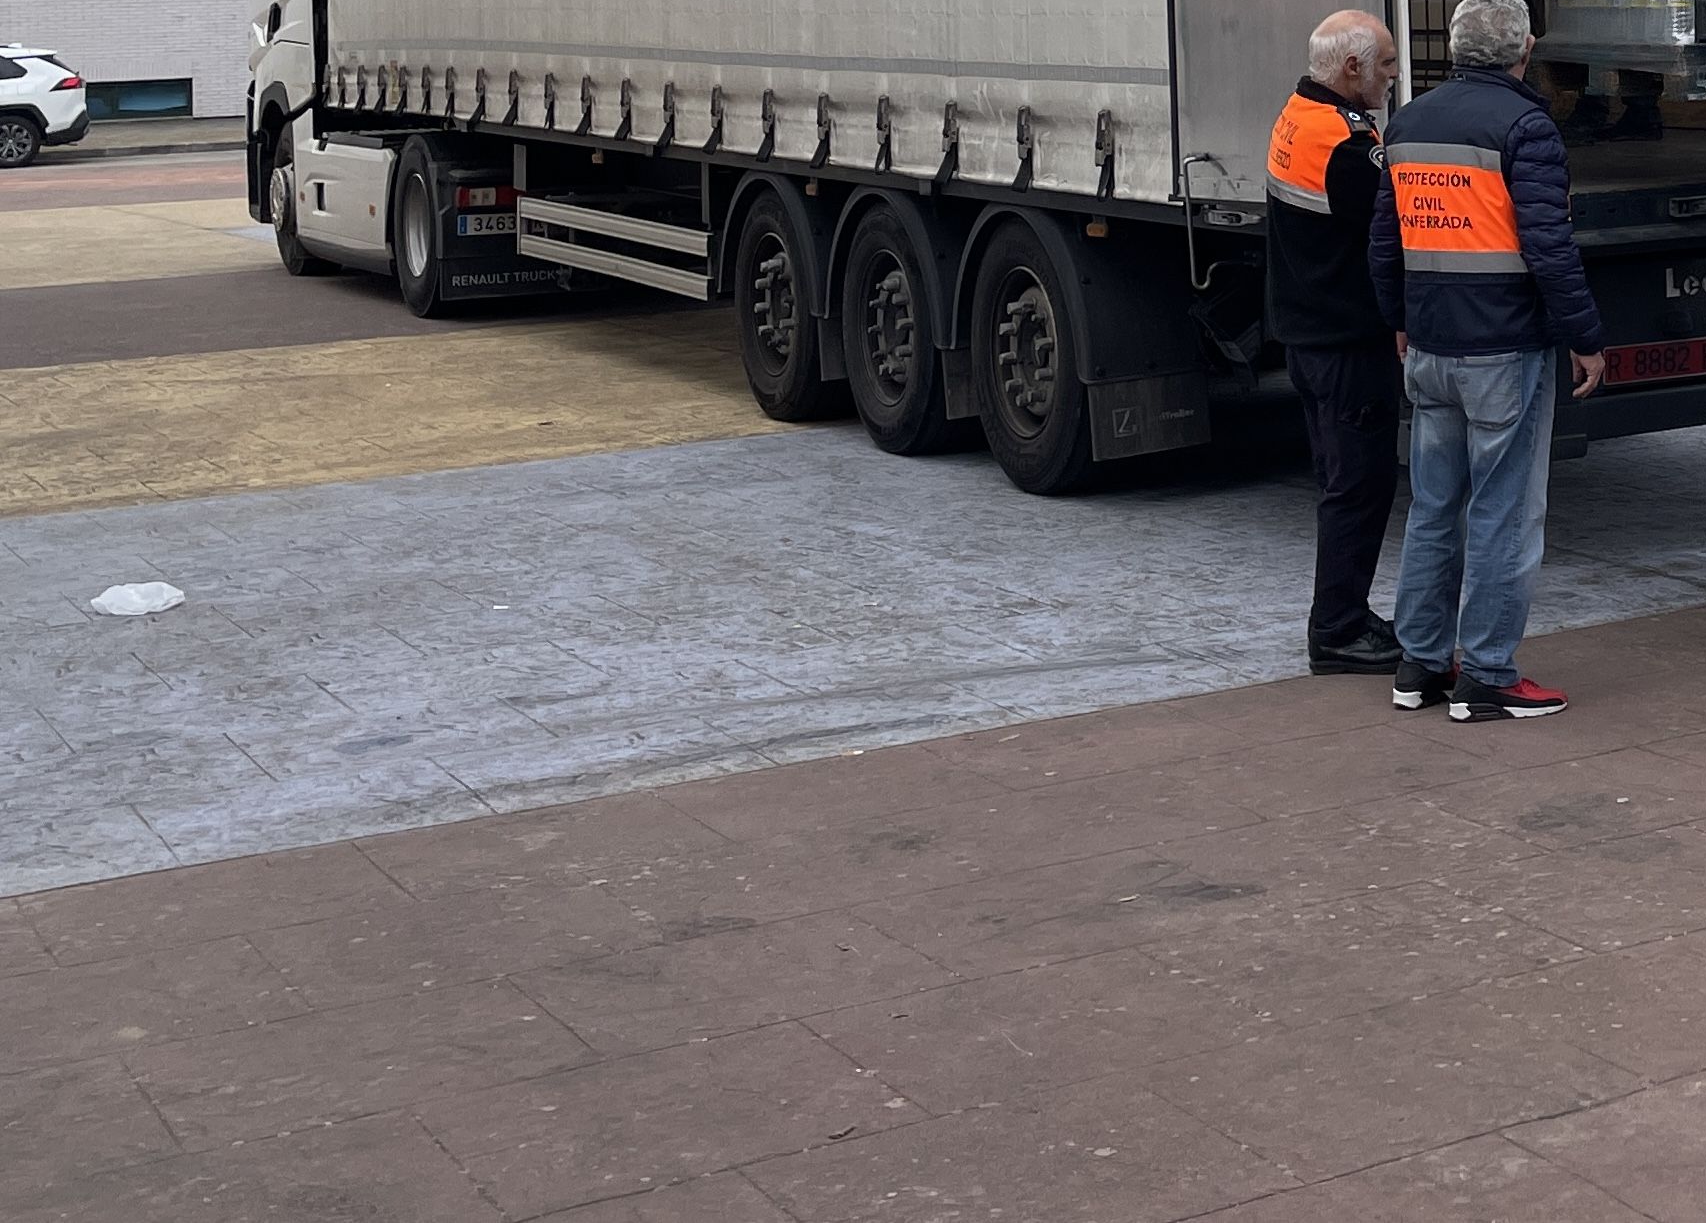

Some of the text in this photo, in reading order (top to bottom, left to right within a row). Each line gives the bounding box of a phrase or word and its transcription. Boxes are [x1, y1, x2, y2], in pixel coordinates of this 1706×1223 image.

[1397, 171, 1472, 188] PROTECCIÓN
[1413, 196, 1446, 211] CIVIL
[473, 215, 517, 233] 3463
[1401, 213, 1474, 230] ONFERRADA
[452, 272, 511, 287] RENAULT
[1634, 346, 1691, 377] 8882
